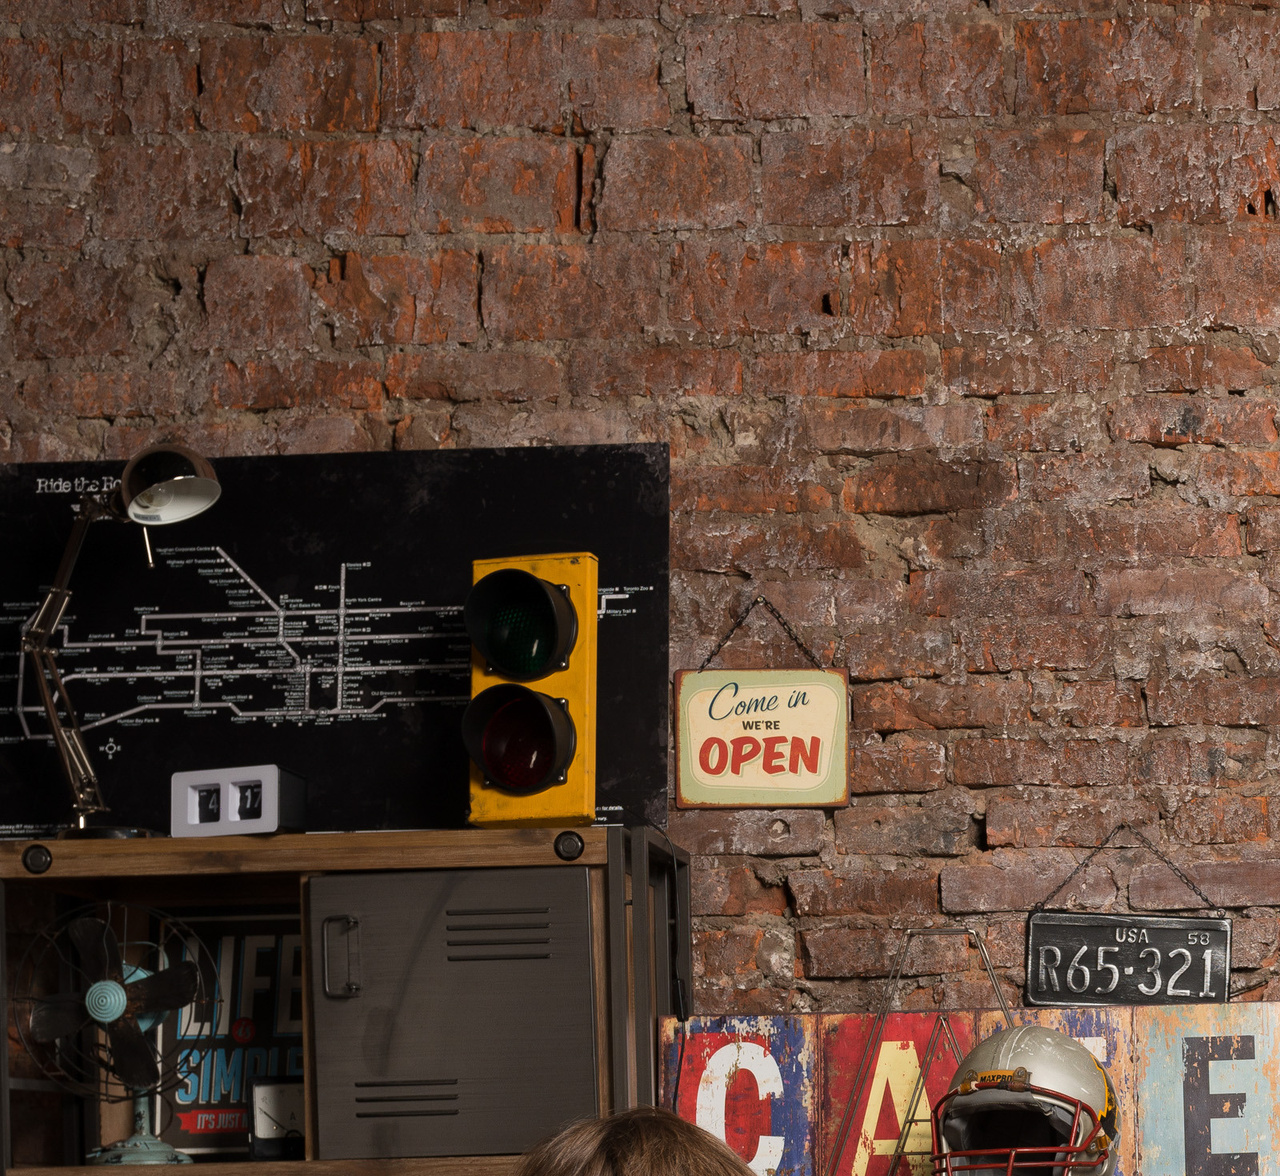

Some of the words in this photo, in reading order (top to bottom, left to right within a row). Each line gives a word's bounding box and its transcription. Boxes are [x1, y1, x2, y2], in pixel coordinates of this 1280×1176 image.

[36, 478, 71, 493] Ride
[75, 477, 99, 493] the
[708, 682, 779, 721] Come
[787, 689, 810, 709] in
[742, 720, 781, 731] WE'RE
[698, 735, 821, 776] OPEN
[245, 787, 262, 809] 17
[1115, 927, 1149, 944] USA
[1187, 931, 1210, 949] 58
[1037, 945, 1217, 999] R65-321
[177, 934, 303, 1040] LIFE
[216, 1112, 241, 1129] JUST
